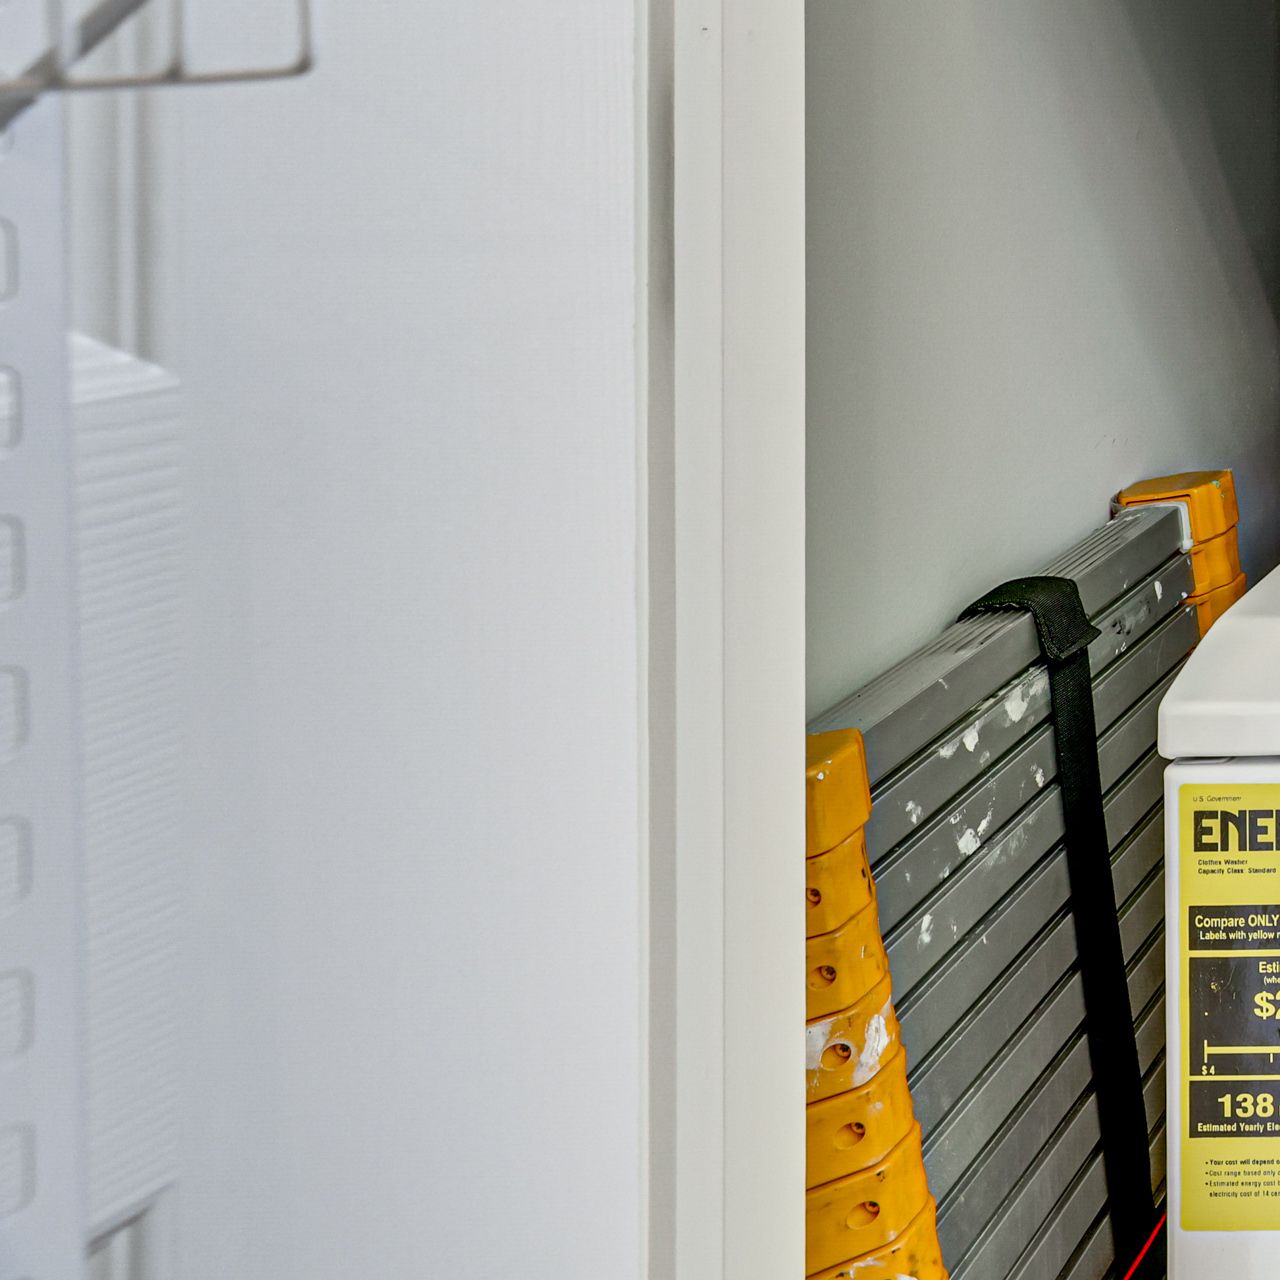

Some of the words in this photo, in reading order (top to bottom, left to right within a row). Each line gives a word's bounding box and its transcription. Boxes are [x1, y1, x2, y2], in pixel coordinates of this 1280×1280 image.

[1195, 915, 1245, 930] Compare
[1248, 914, 1279, 927] ONLY
[1200, 930, 1226, 940] Labels
[1229, 930, 1246, 939] with
[1248, 929, 1275, 941] yellow
[1218, 1093, 1274, 1118] 138
[1197, 1123, 1236, 1132] Estimated
[1239, 1122, 1264, 1133] Yearly
